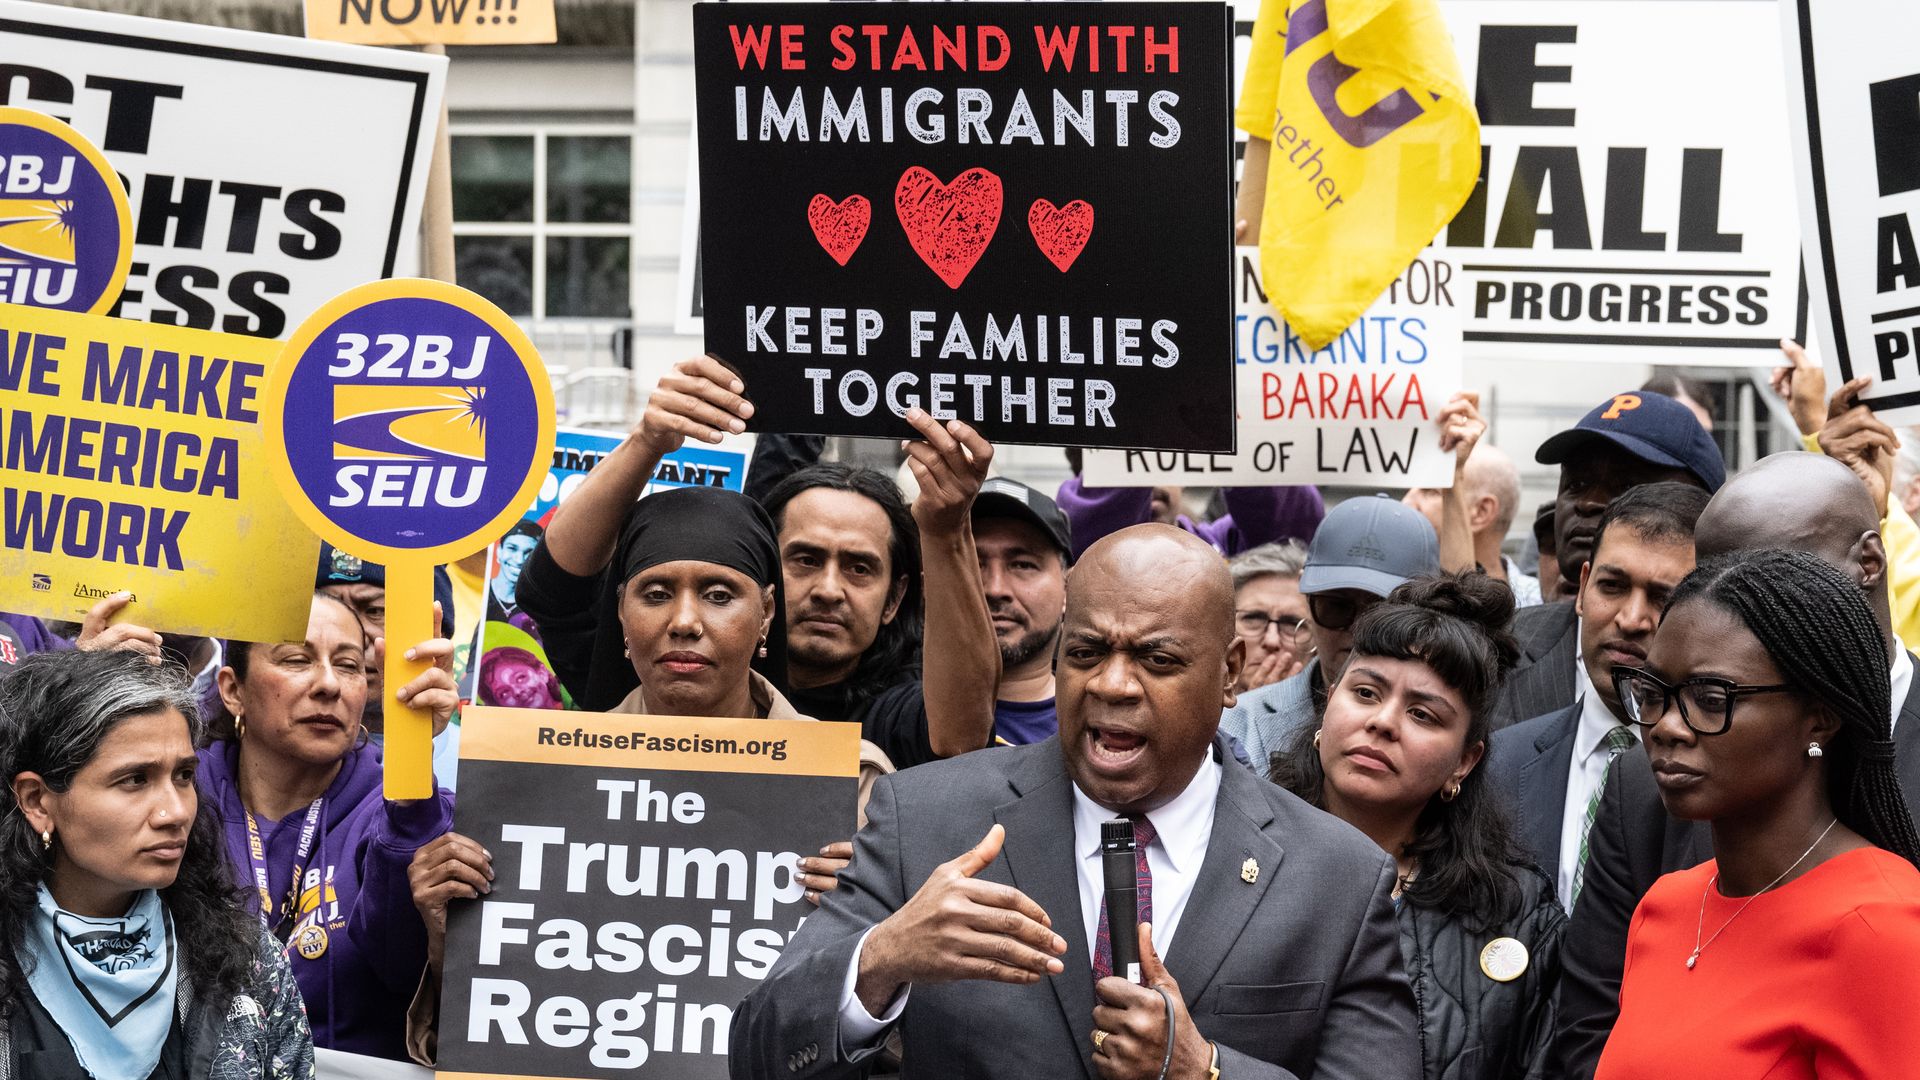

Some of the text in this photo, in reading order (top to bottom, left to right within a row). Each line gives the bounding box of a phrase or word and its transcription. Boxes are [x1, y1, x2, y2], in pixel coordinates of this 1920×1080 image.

[728, 25, 1179, 73] WE STAND WITH
[735, 86, 1182, 149] IMMIGRANTS
[0, 155, 76, 195] BJ
[1474, 280, 1769, 325] PROGRESS
[328, 333, 491, 381] 32BJ
[745, 305, 1179, 368] KEEP FAMILIES
[82, 341, 265, 424] MAKE
[805, 368, 1117, 428] TOGETHER
[1262, 372, 1429, 420] BARAKA
[1600, 394, 1642, 419] P
[0, 408, 240, 500] MERICA
[1253, 441, 1295, 473] OF
[1317, 428, 1420, 475] LAW
[329, 465, 486, 507] SEIU
[4, 488, 191, 571] WORK
[538, 727, 788, 761] RefuseFascism.org
[596, 778, 706, 824] The
[297, 822, 316, 858] RACIAL
[501, 824, 806, 920] Trump
[303, 942, 323, 955] FLY!
[478, 901, 807, 980] Fascis
